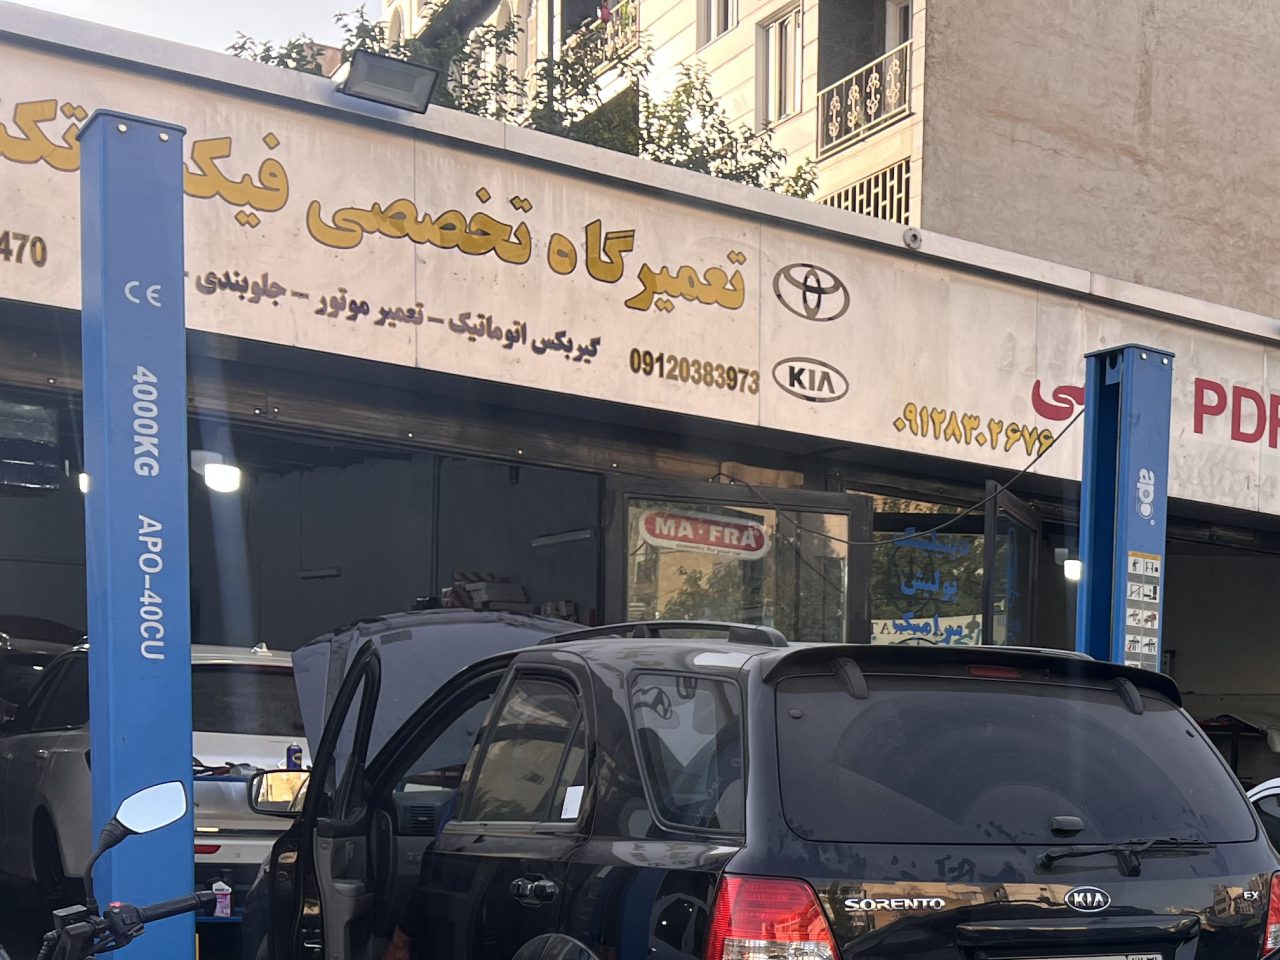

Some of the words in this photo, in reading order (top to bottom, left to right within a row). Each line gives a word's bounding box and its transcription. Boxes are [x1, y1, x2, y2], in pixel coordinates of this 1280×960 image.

[306, 187, 531, 264] تخصصی
[547, 218, 746, 312] تعمیرگاه
[196, 271, 286, 307] جلوبندی
[314, 287, 370, 321] موتور
[374, 302, 424, 328] تعمیر
[450, 312, 527, 349] اتوماتیک
[629, 348, 760, 395] 09120383973
[787, 365, 834, 393] KIA
[133, 365, 160, 477] 4000KG
[138, 514, 164, 660] APO-40CU
[844, 898, 945, 911] SORENTO
